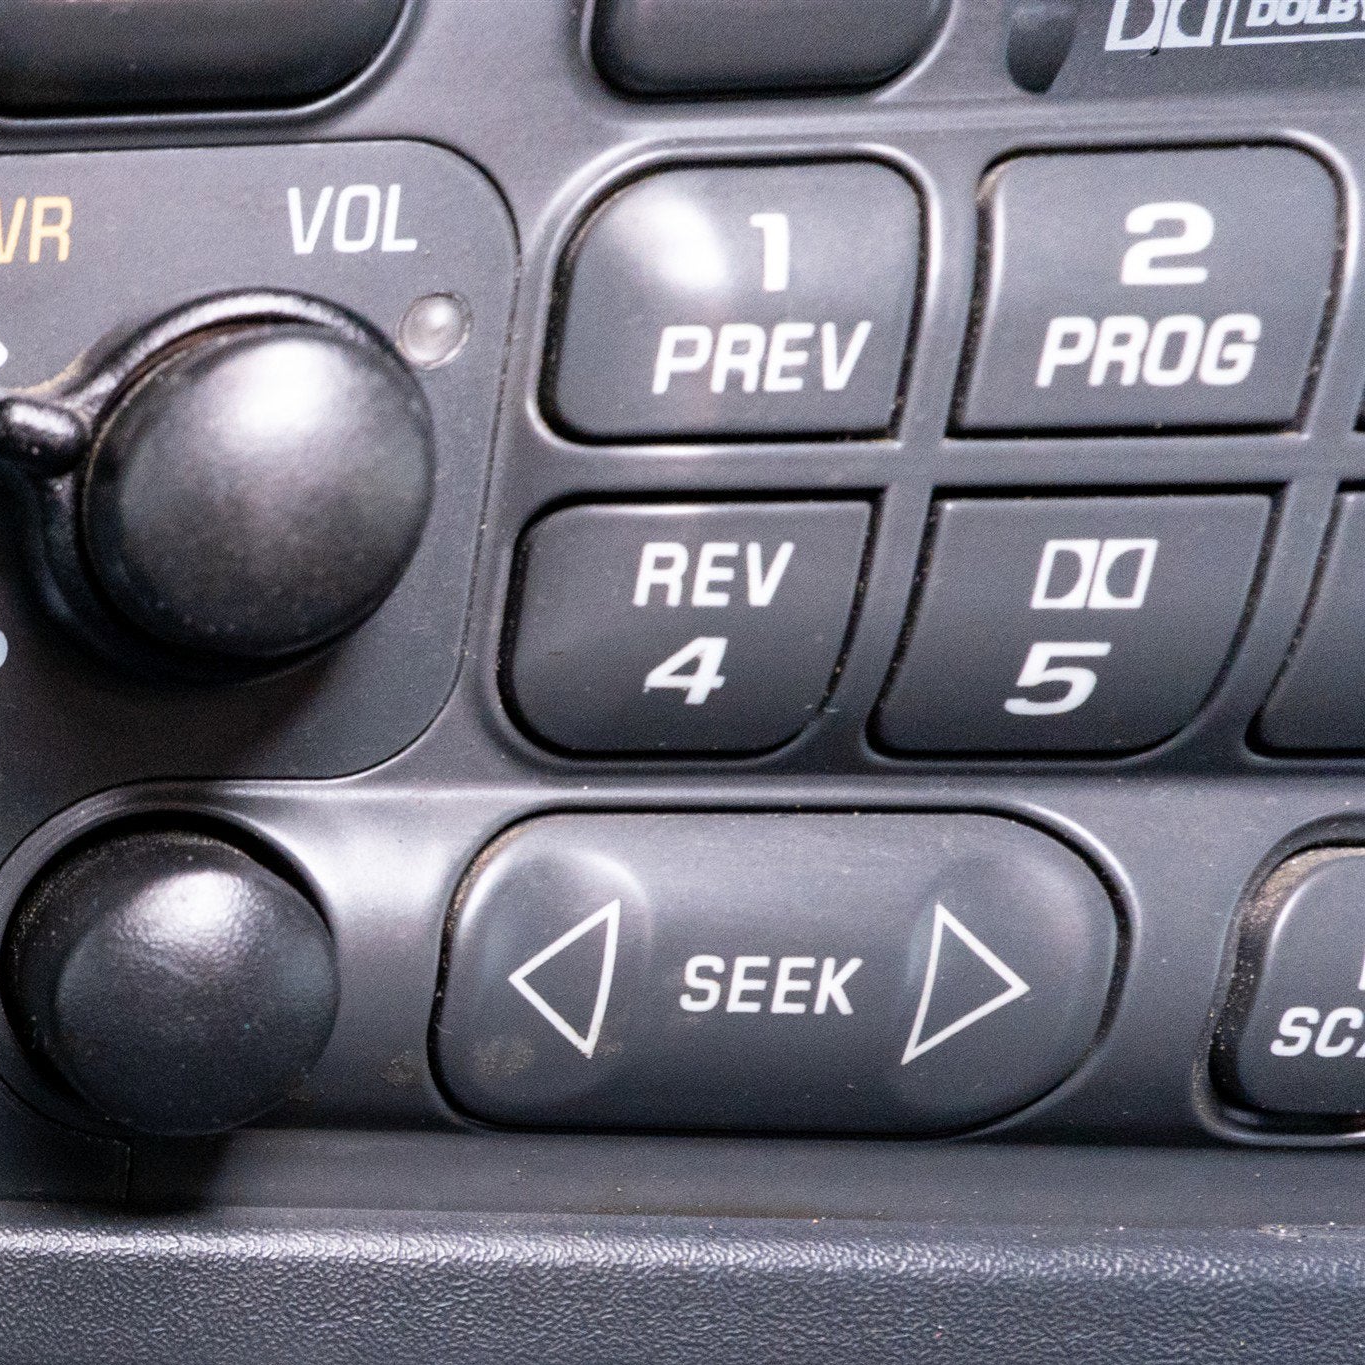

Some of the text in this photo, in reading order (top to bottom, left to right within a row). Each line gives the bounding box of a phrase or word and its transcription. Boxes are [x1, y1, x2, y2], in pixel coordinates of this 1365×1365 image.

[1245, 0, 1365, 28] DOLB
[286, 184, 418, 255] VOL
[748, 213, 791, 293] 1
[1119, 201, 1215, 286] 2
[651, 320, 873, 395] PREV
[1035, 314, 1262, 388] PROG
[632, 540, 795, 608] REV
[641, 634, 729, 706] 4
[1003, 641, 1111, 716] 5
[678, 954, 865, 1017] SEEK
[1269, 1006, 1365, 1058] SC
